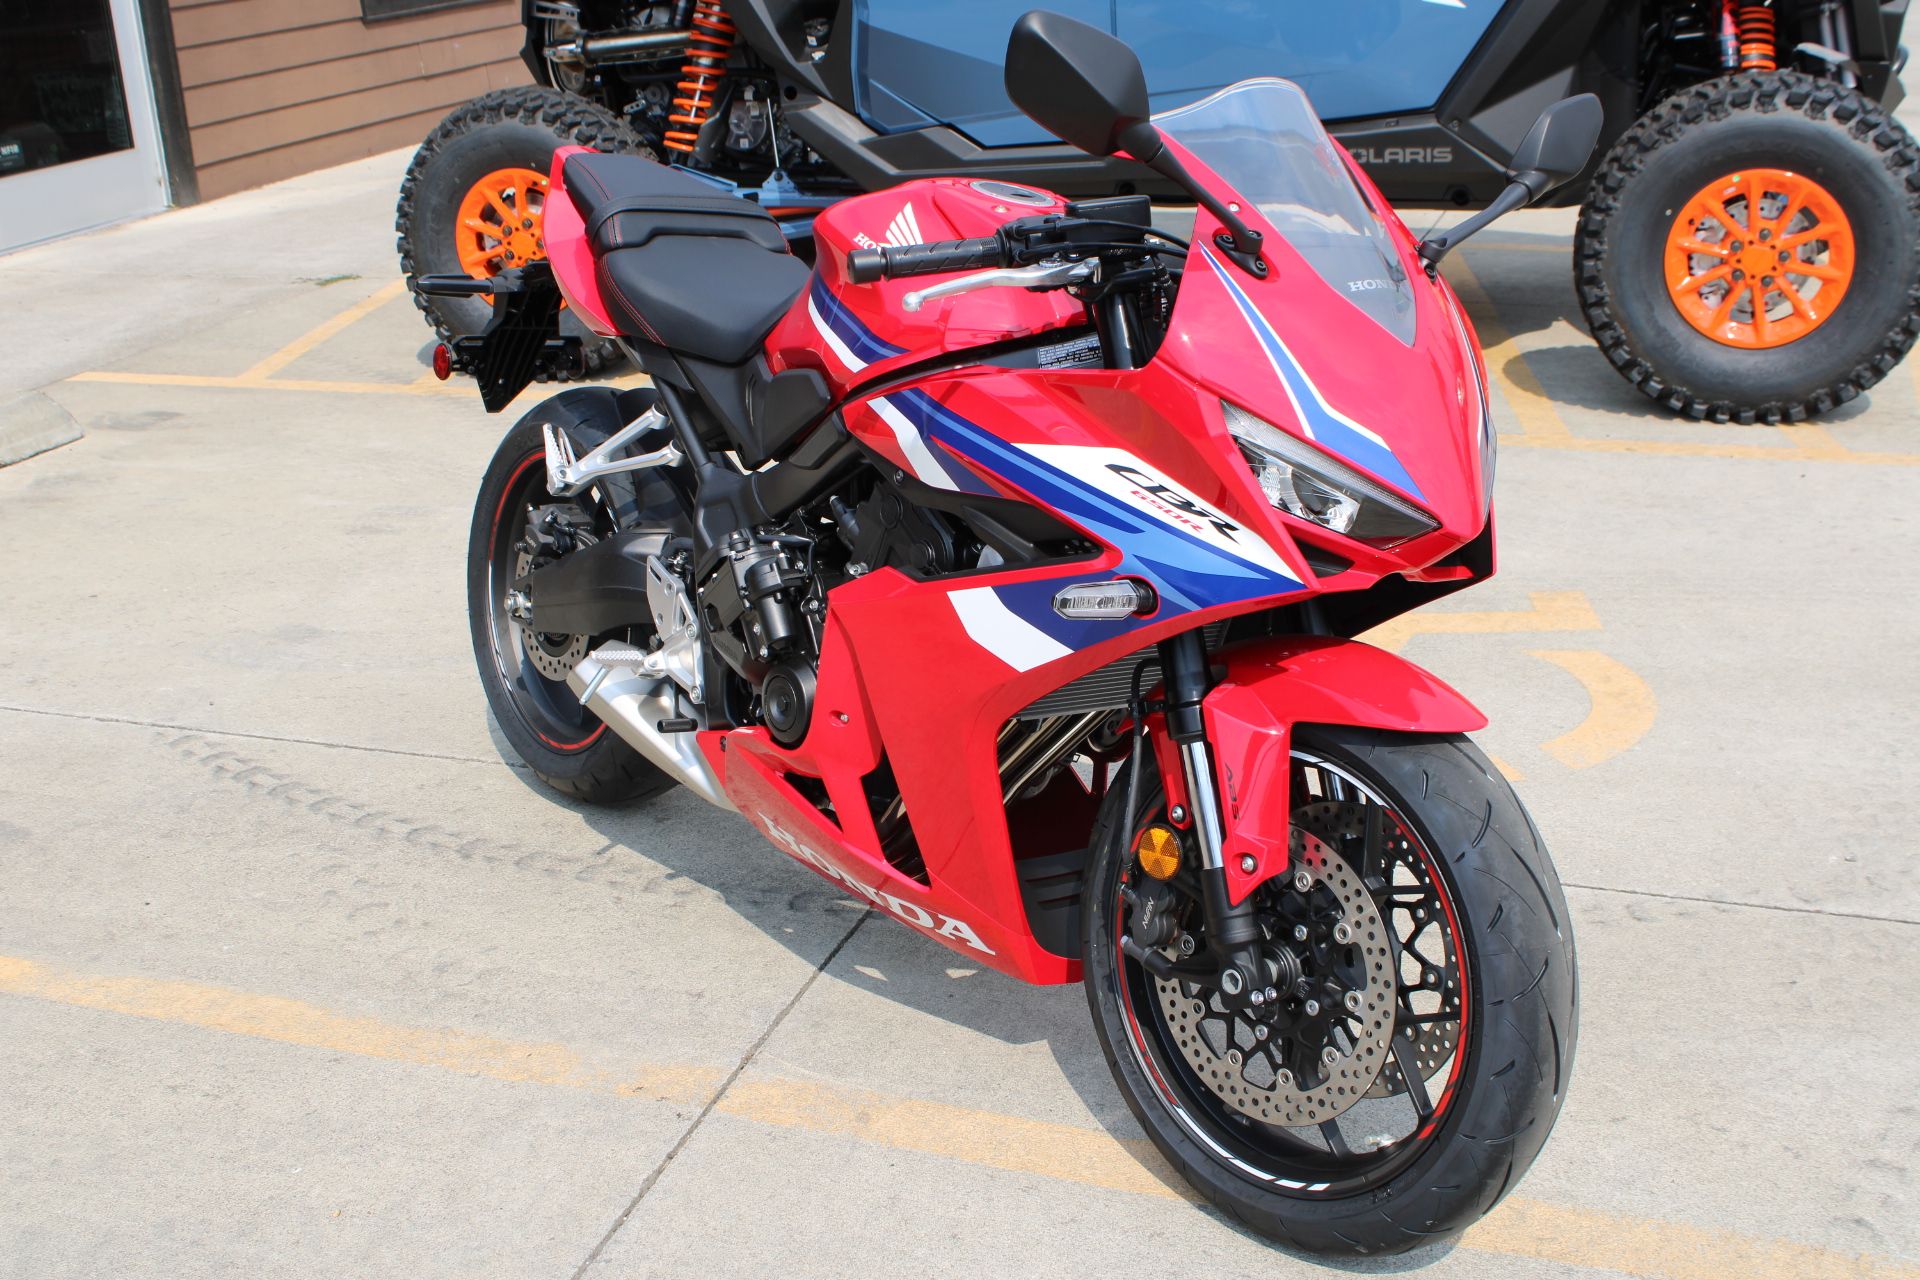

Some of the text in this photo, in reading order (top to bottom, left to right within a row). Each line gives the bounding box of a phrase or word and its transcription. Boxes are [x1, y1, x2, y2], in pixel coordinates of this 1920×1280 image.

[1347, 147, 1453, 163] OLARIS
[853, 231, 882, 255] HO
[1104, 463, 1241, 545] CBR
[1130, 490, 1204, 533] 650R
[1225, 762, 1241, 820] ABS
[757, 811, 995, 955] HONDA
